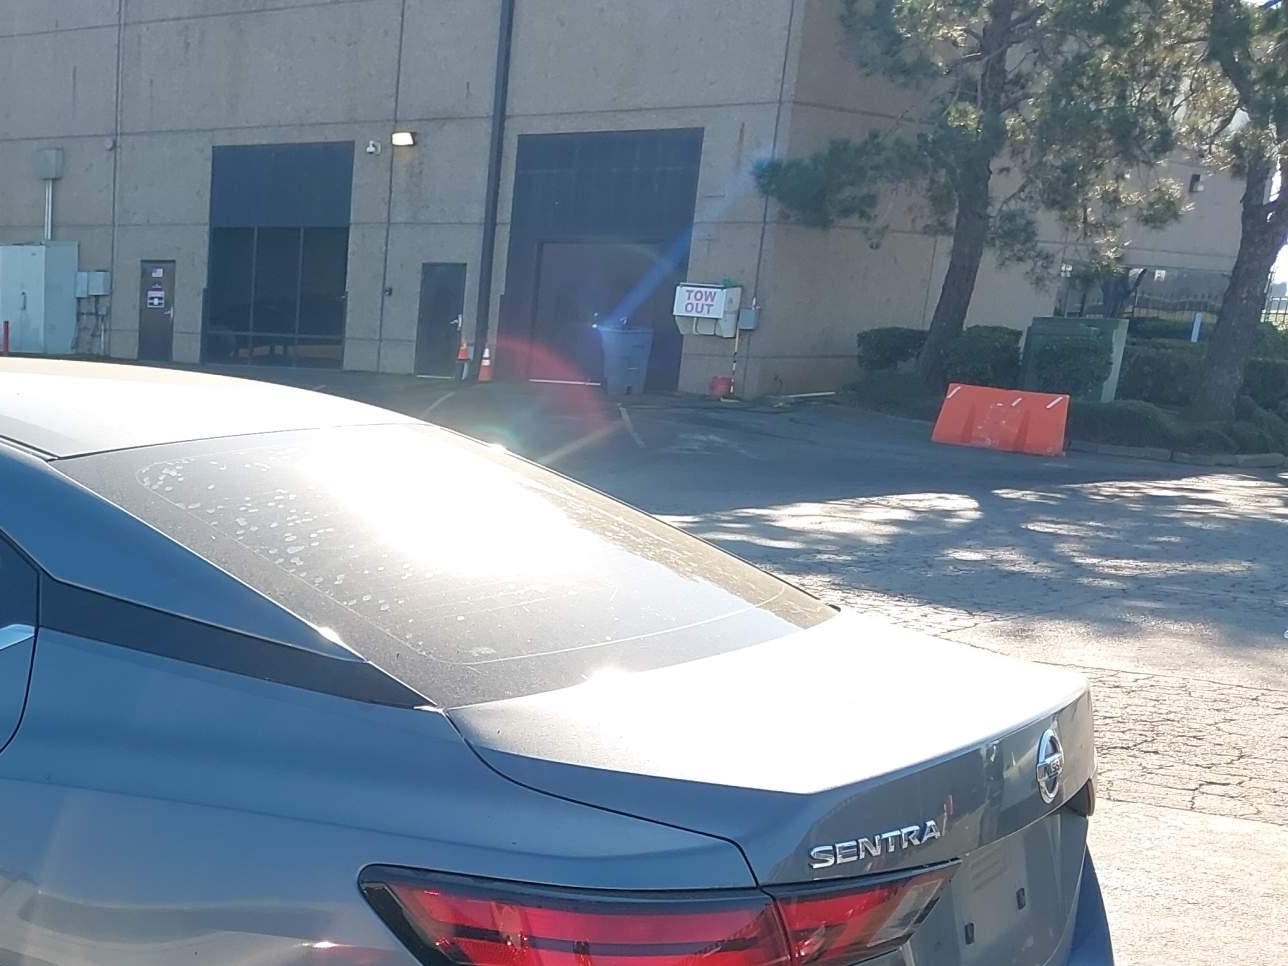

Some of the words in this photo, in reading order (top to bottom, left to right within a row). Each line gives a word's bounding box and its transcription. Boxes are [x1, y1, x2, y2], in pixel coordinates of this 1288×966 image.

[686, 290, 716, 302] TOW
[685, 303, 714, 314] OUT
[809, 819, 941, 869] SENTRA
